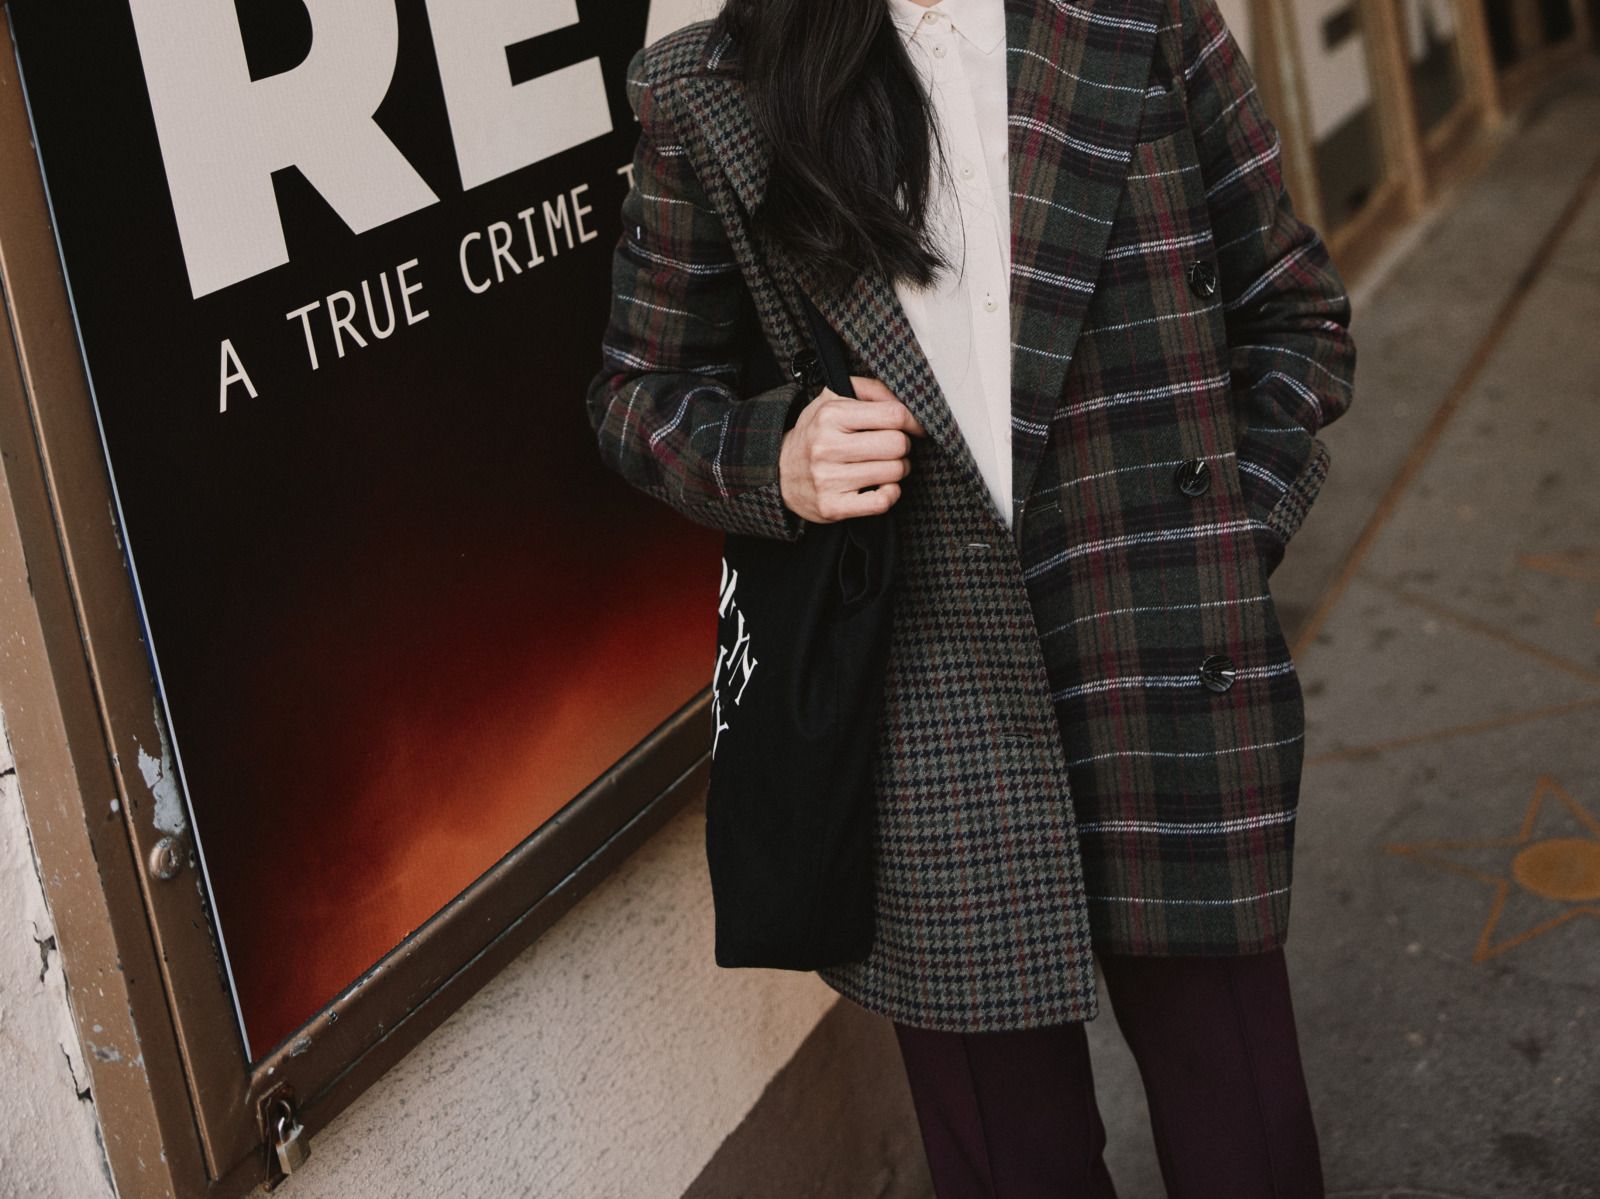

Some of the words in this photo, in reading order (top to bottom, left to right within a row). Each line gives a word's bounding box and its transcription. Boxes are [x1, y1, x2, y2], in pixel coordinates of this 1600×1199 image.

[219, 338, 259, 414] A
[285, 257, 430, 371] TRUE
[459, 183, 599, 294] CRIME
